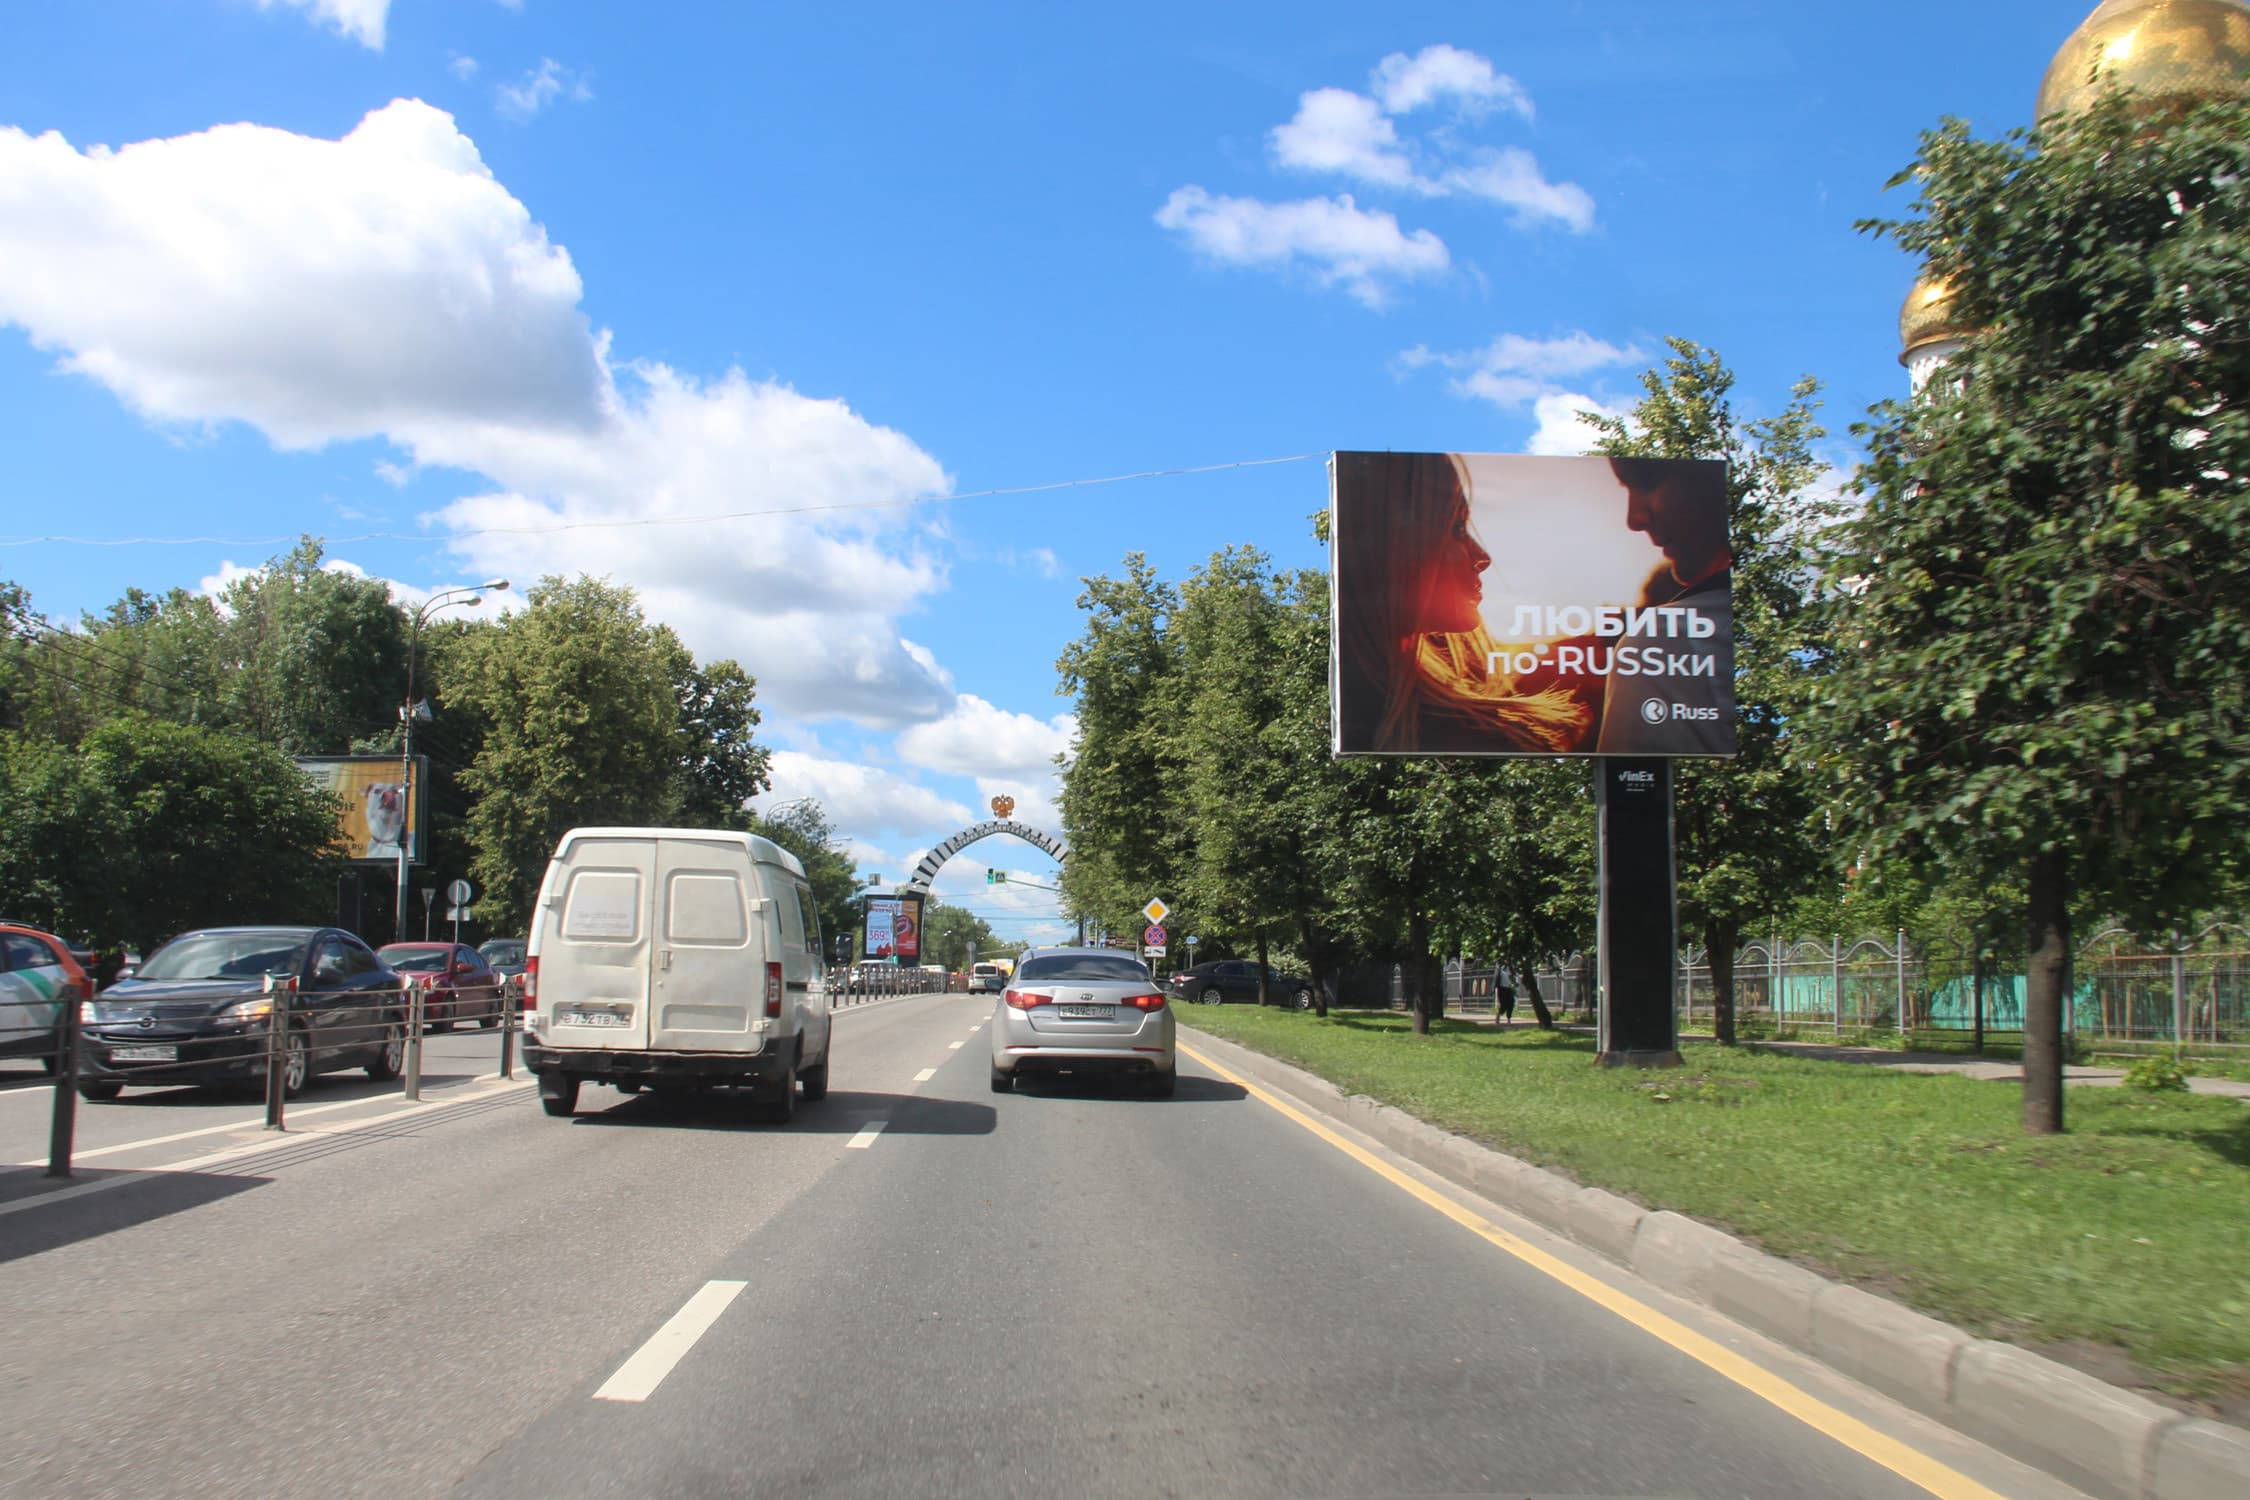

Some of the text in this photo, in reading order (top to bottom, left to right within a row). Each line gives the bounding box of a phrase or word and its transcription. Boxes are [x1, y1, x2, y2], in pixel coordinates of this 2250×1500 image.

[1508, 604, 1716, 639] ЛЮБИТЬ
[1487, 645, 1716, 677] по-RUSSки
[1671, 703, 1719, 720] Russ
